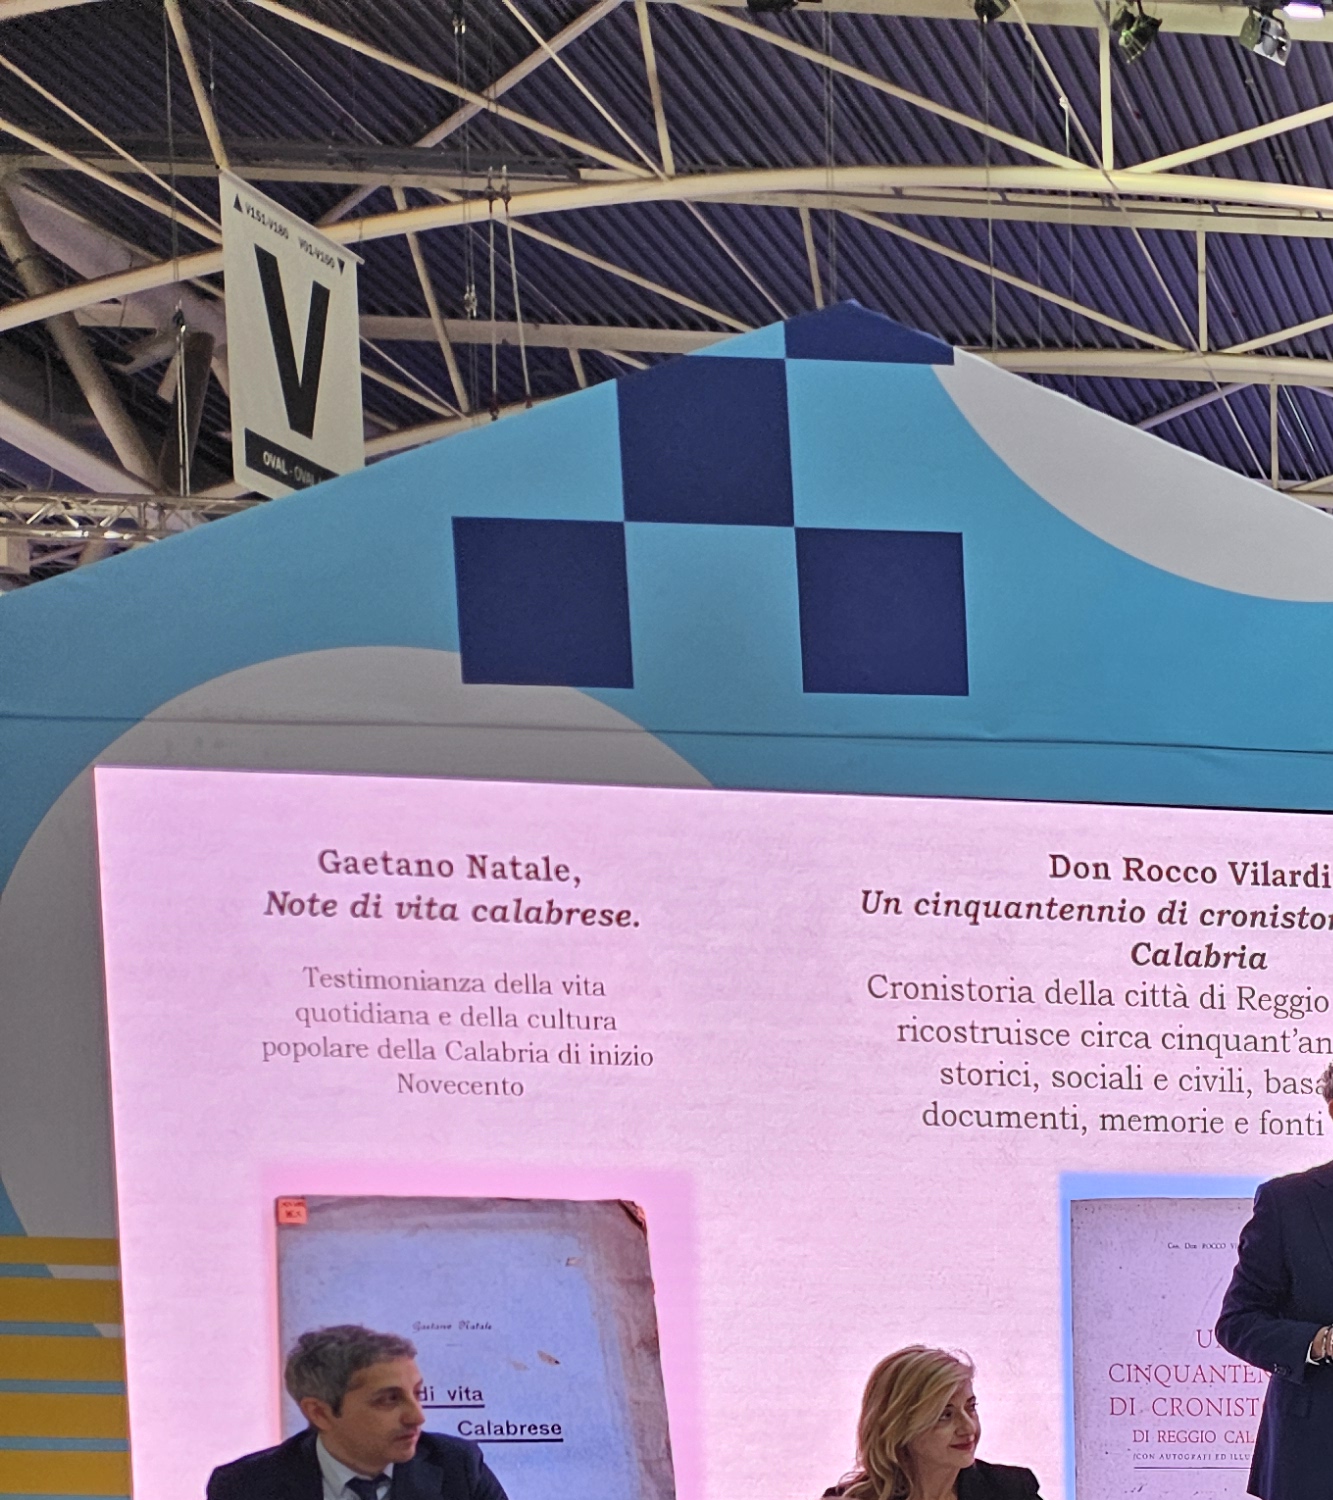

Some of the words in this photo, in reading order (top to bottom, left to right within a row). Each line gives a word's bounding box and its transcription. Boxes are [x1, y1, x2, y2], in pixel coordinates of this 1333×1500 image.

[254, 243, 330, 440] V
[263, 451, 288, 475] OVAL
[318, 849, 454, 877] Gaetano
[467, 854, 582, 888] Natale,
[1049, 854, 1111, 881] Don
[1122, 857, 1217, 885] Rocco
[263, 891, 338, 917] Note
[350, 893, 382, 919] di
[397, 895, 459, 921] vita
[471, 898, 641, 928] calabrese.
[861, 890, 902, 915] Un
[914, 891, 1146, 927] cinquantennio
[1157, 900, 1189, 926] di
[1131, 941, 1269, 971] Calabria
[303, 966, 485, 993] Testimonianza
[494, 972, 552, 995] della
[562, 974, 606, 996] vita
[867, 974, 1036, 1004] Cronistoria
[1045, 978, 1116, 1008] della
[1125, 981, 1190, 1009] città
[1200, 983, 1227, 1011] di
[1237, 985, 1329, 1019] Reggio
[295, 1003, 429, 1028] quotidiana
[439, 1011, 451, 1026] e
[460, 1007, 518, 1028] della
[527, 1009, 617, 1031] cultura
[897, 1019, 1071, 1048] ricostruisce
[1081, 1023, 1152, 1050] circa
[262, 1037, 369, 1062] popolare
[378, 1038, 437, 1060] della
[446, 1040, 549, 1064] Calabria
[558, 1043, 580, 1065] di
[590, 1045, 654, 1067] inizio
[397, 1073, 524, 1096] Novecento
[940, 1062, 1040, 1093] storici,
[1051, 1065, 1144, 1093] sociali
[1154, 1072, 1168, 1092] e
[1179, 1066, 1254, 1098] civili,
[922, 1101, 1089, 1136] documenti,
[1100, 1106, 1225, 1135] memorie
[1235, 1115, 1249, 1135] e
[1260, 1107, 1324, 1137] fonti
[447, 1386, 484, 1401] vita
[1110, 1398, 1135, 1416] DI
[1152, 1398, 1259, 1417] CRONIST
[458, 1420, 562, 1436] Calabrese
[1133, 1430, 1149, 1443] DI
[1158, 1430, 1216, 1444] REGGIO
